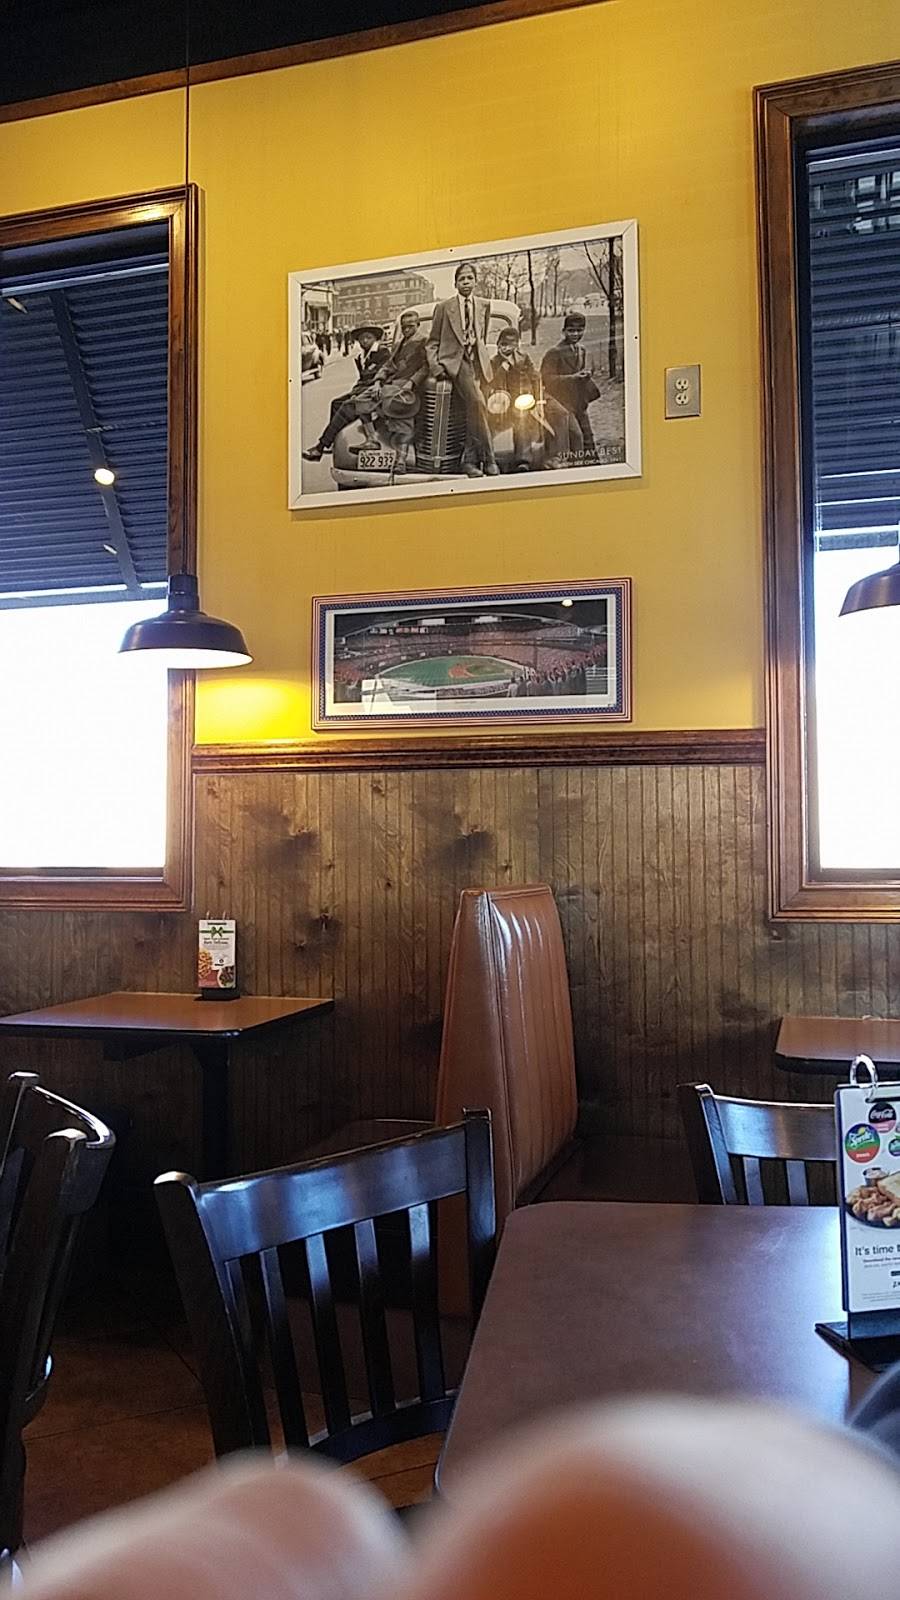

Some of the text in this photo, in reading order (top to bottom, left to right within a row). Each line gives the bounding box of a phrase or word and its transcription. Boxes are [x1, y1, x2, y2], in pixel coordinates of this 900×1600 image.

[558, 446, 622, 460] SUNDAY BEST
[360, 456, 376, 468] 922
[855, 1246, 870, 1256] It's
[872, 1245, 894, 1255] time
